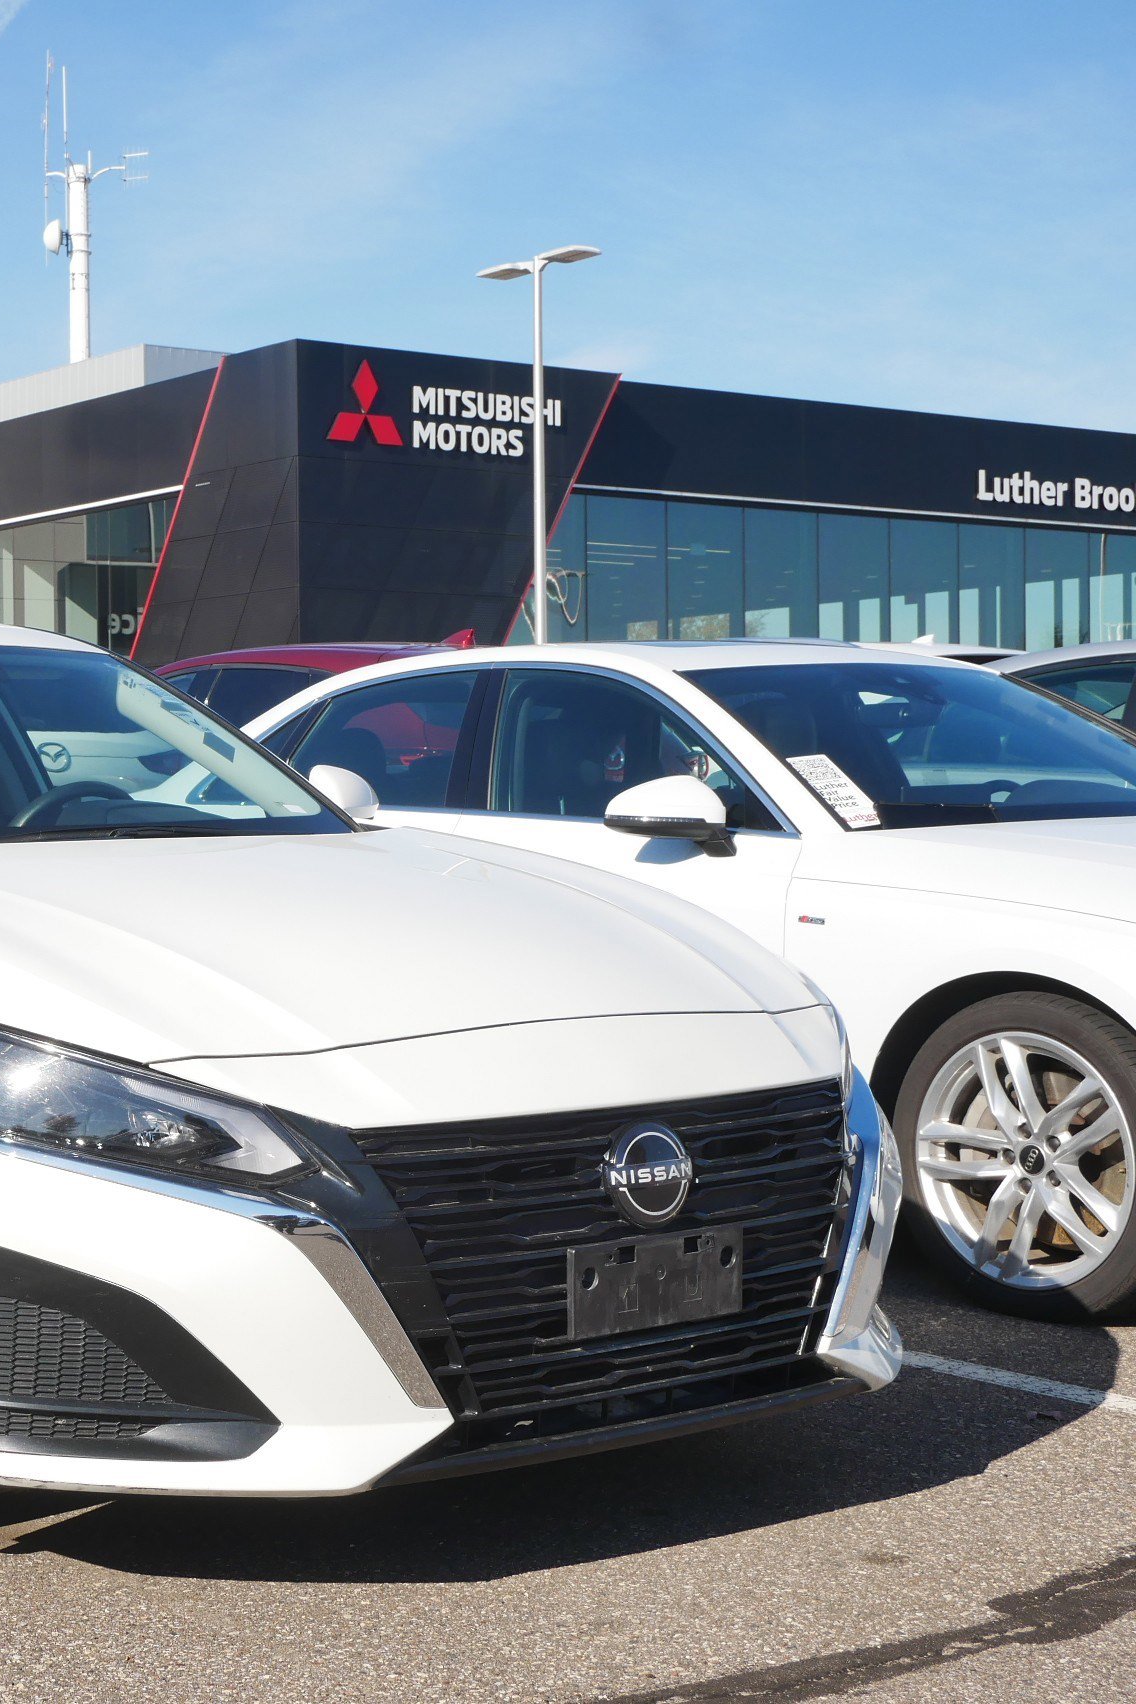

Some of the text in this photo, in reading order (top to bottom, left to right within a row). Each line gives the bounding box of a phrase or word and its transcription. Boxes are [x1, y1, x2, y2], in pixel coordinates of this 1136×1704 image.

[413, 385, 562, 427] MITSUBISHI
[413, 420, 524, 457] MOTORS
[977, 469, 1068, 507] Luther
[813, 782, 849, 791] Luther
[831, 801, 859, 809] Price
[610, 1161, 692, 1186] NISSAN
